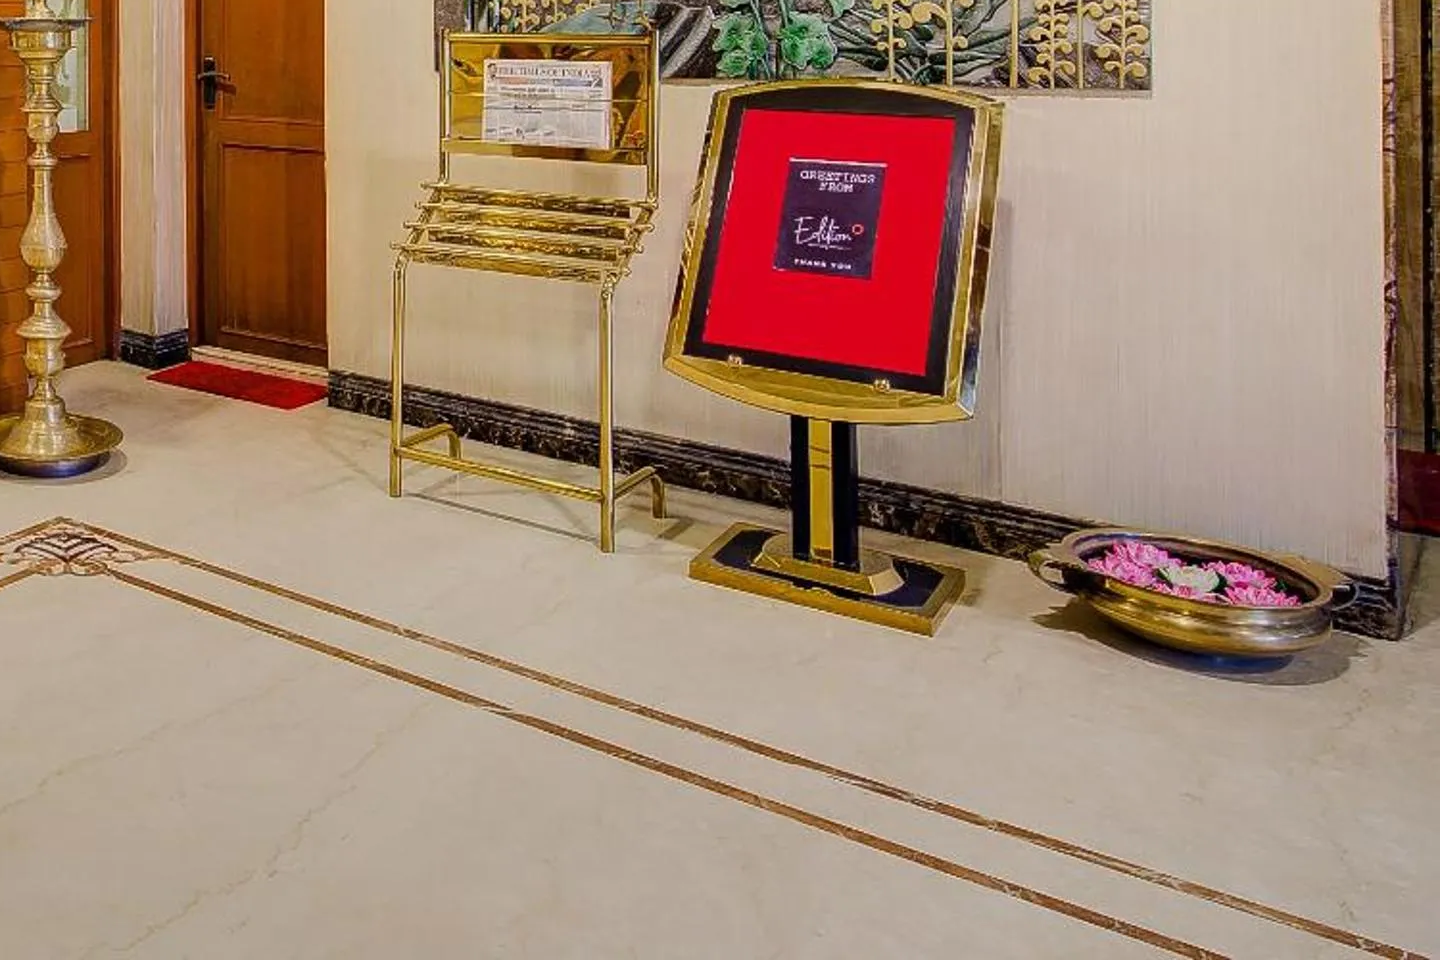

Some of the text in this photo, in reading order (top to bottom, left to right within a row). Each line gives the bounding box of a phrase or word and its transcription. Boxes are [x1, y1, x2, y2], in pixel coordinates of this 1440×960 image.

[800, 170, 876, 183] GREETINGS
[819, 182, 854, 193] FROM
[830, 262, 852, 270] YOU
